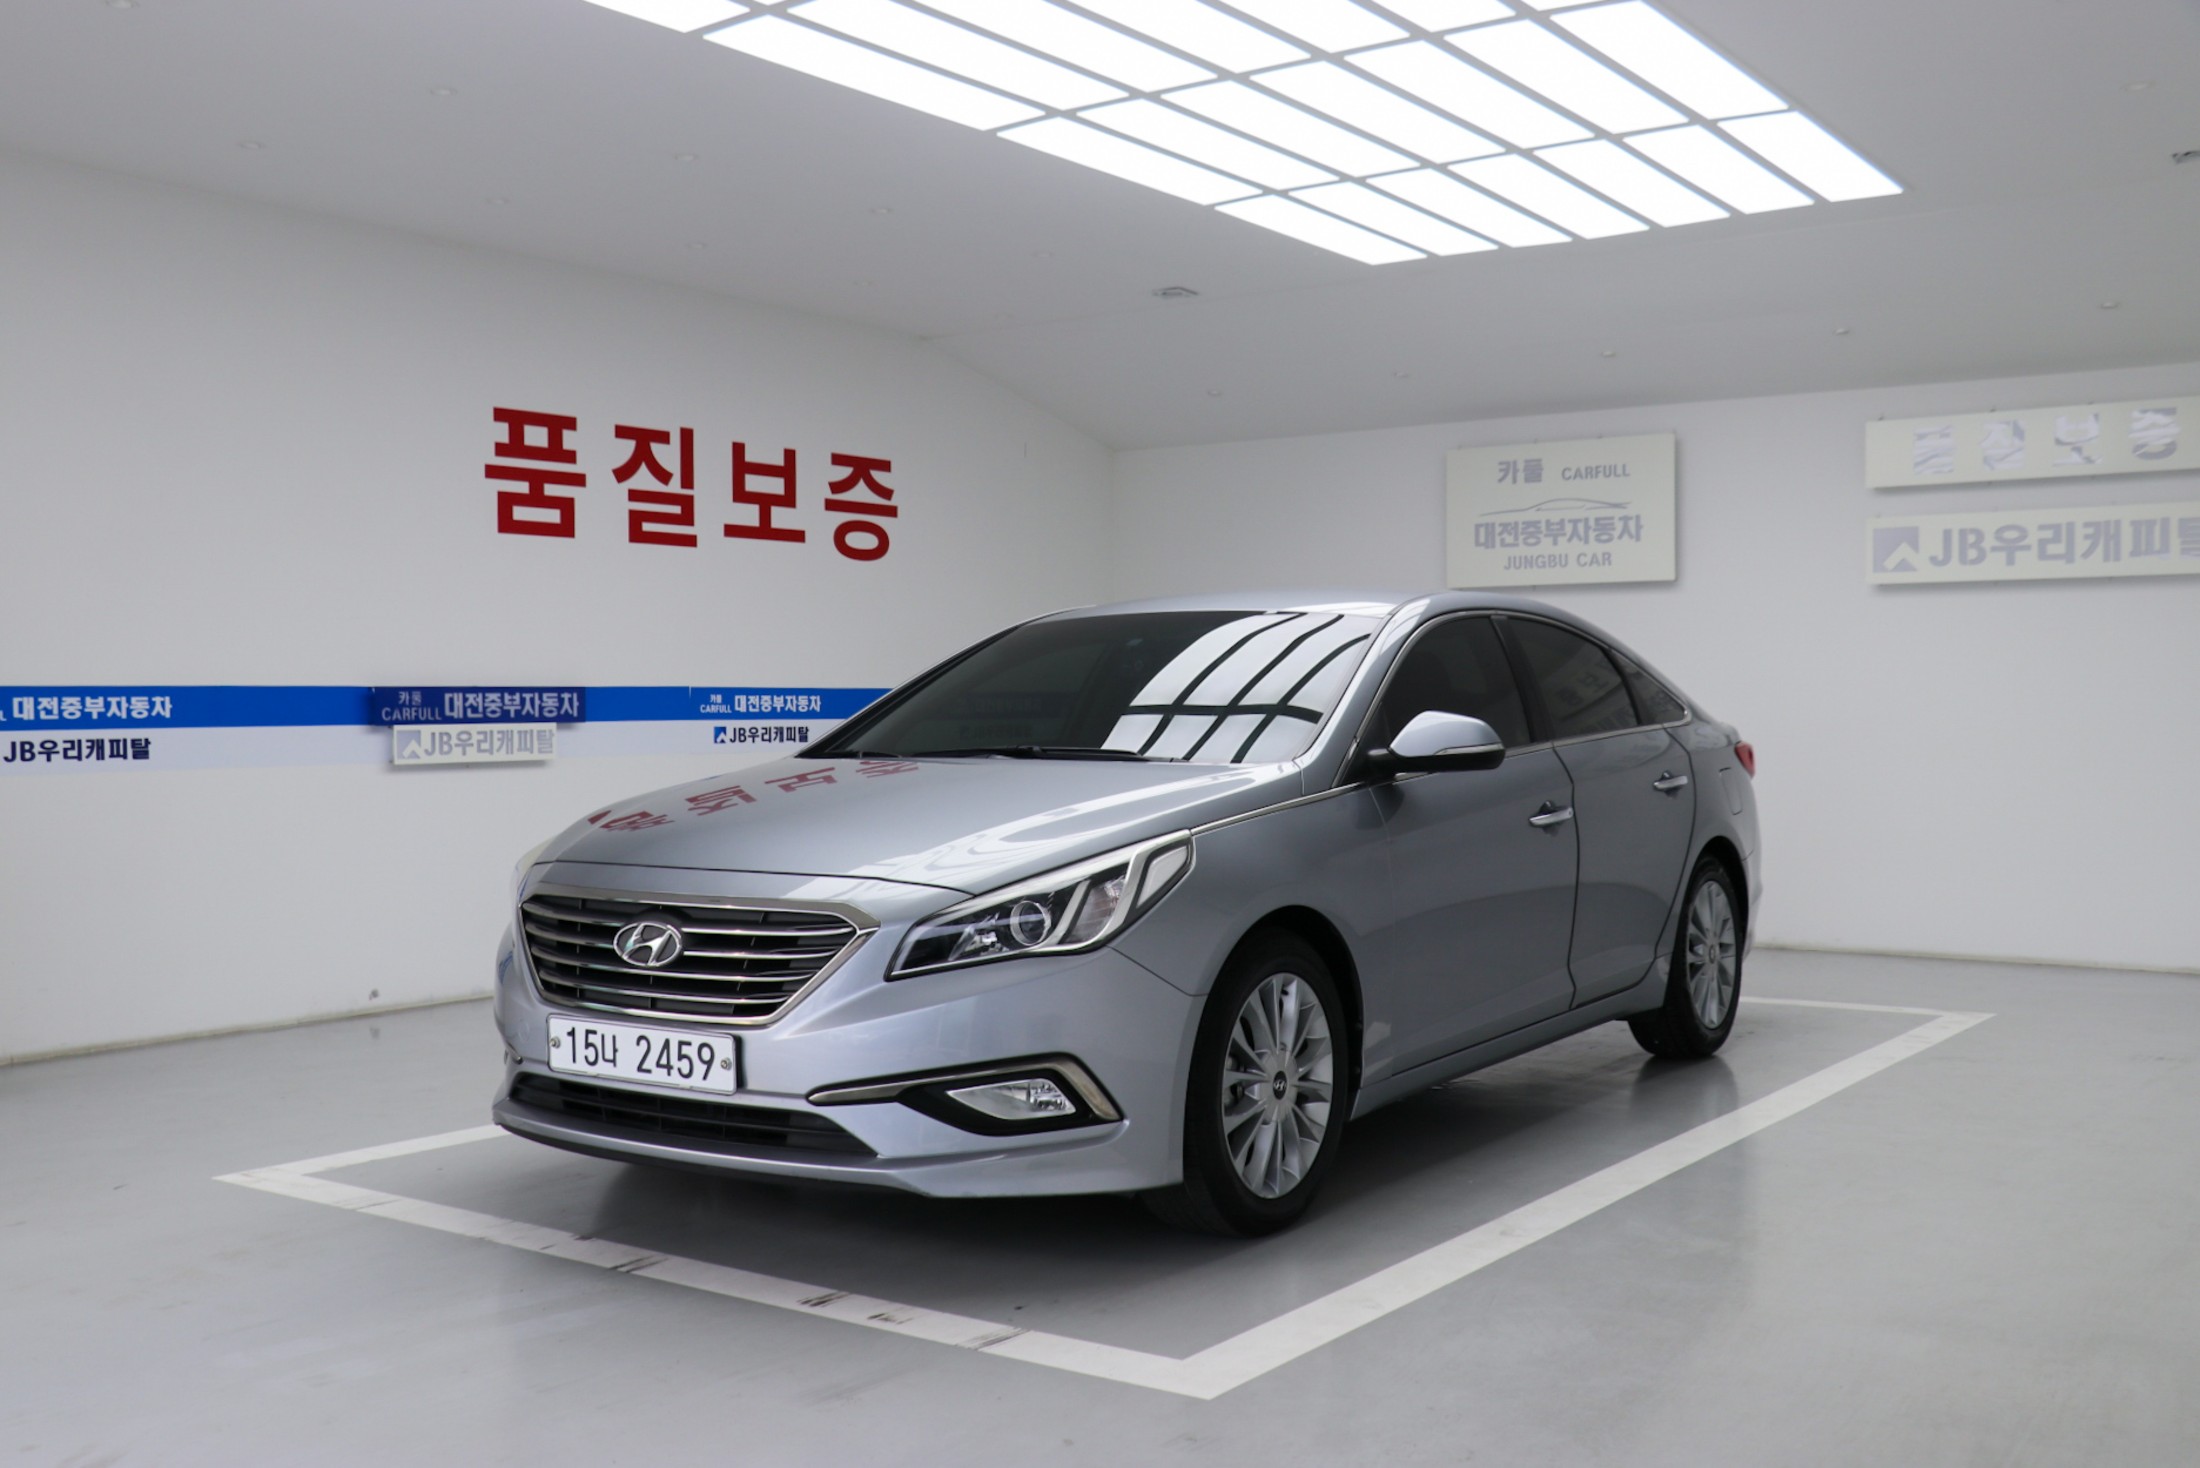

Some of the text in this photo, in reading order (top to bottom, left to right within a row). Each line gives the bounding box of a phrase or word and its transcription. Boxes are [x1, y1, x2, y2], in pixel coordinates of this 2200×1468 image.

[485, 407, 898, 561] 품질보증
[1561, 464, 1630, 481] CARFULL
[1474, 514, 1643, 549] 대전중부자동차
[1504, 552, 1612, 570] JUNGBU CAR
[12, 696, 172, 720] 대전중부자동차
[381, 707, 442, 721] CARFULL
[444, 692, 579, 719] 대전중부자동차
[700, 704, 732, 713] CARFULL
[734, 695, 821, 713] 대전중부자동차
[424, 729, 555, 757] JB우리캐피탈
[729, 726, 809, 744] JB우리캐피탈
[3, 738, 152, 763] JB우리캐피탈
[567, 1027, 715, 1081] 15나 2459
